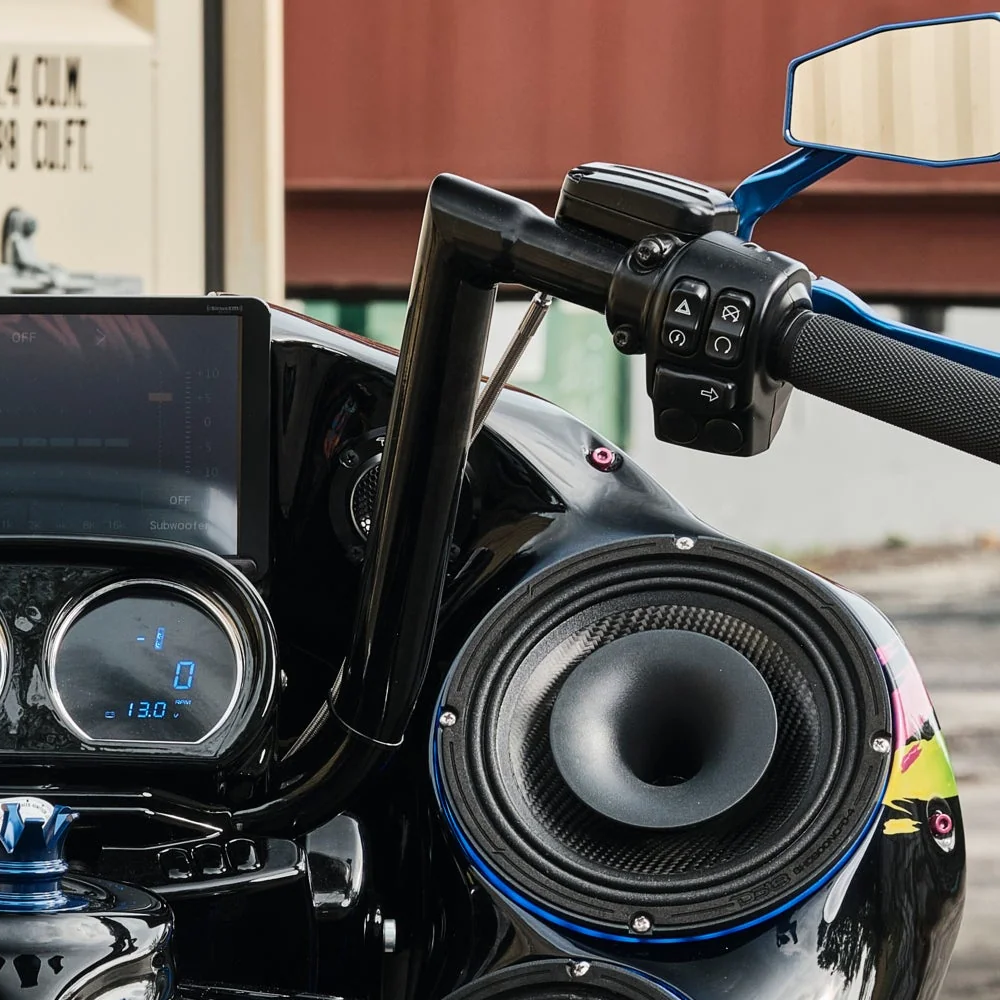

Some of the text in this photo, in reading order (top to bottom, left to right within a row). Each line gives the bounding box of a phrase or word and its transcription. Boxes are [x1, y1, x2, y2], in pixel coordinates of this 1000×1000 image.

[11, 331, 37, 344] OFF
[169, 495, 191, 505] OFF
[173, 661, 195, 690] 0
[127, 701, 167, 718] 13.0
